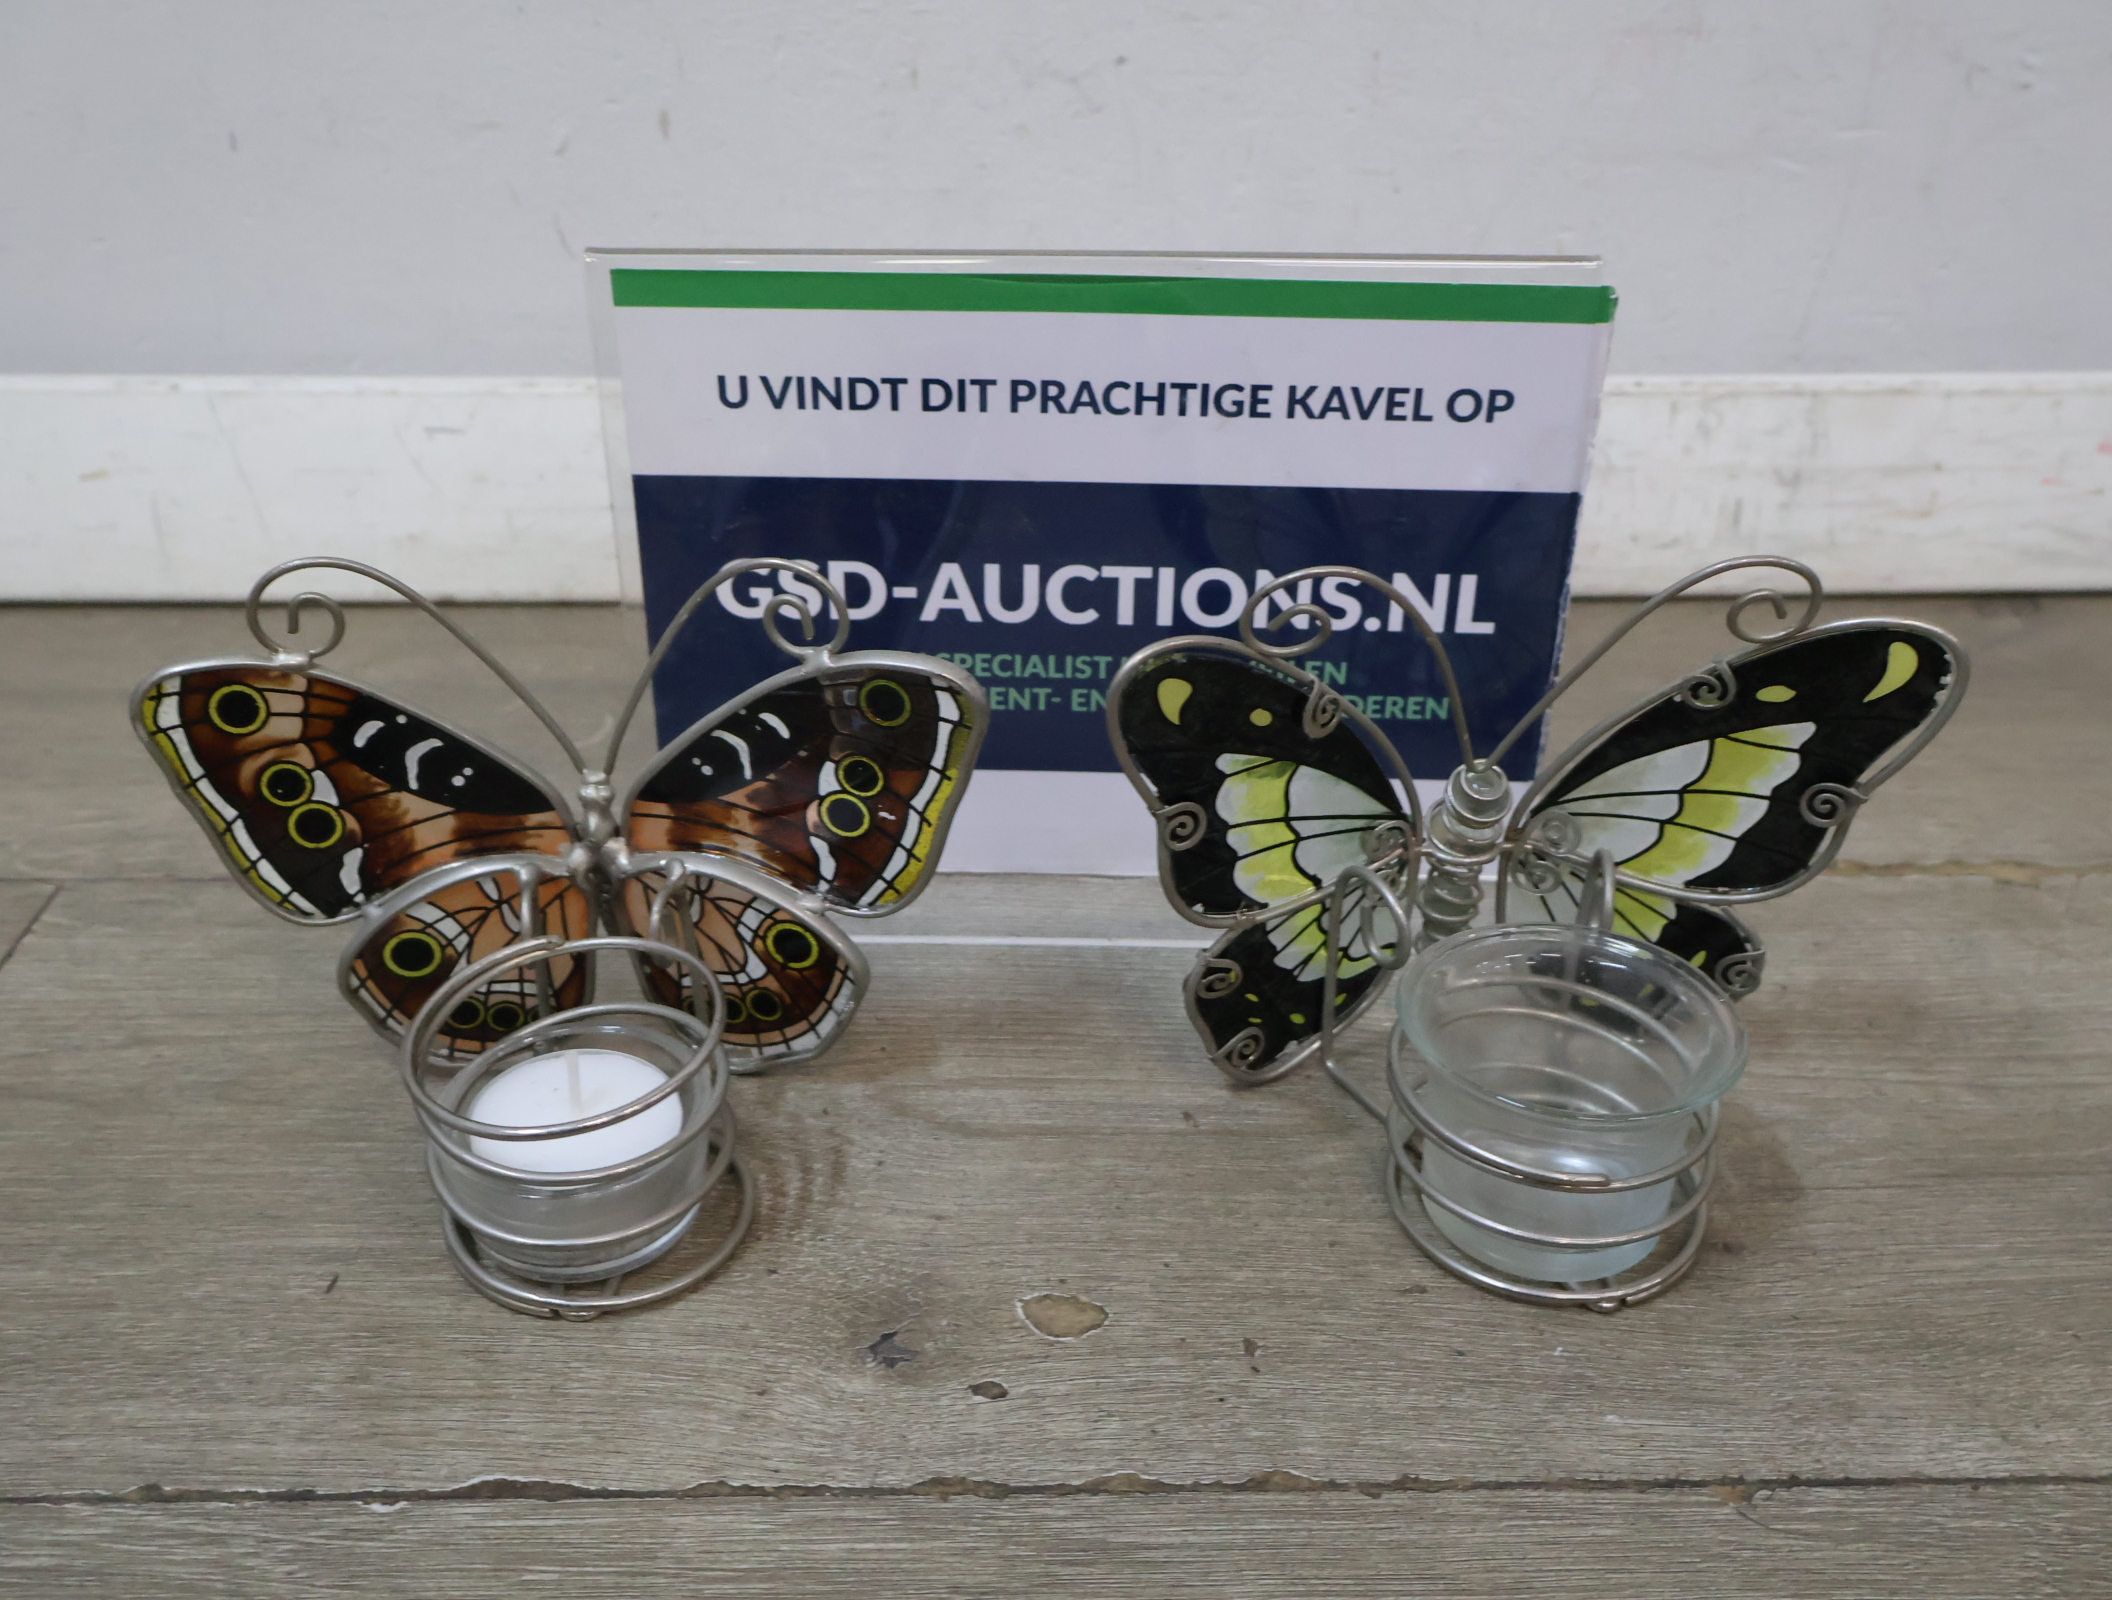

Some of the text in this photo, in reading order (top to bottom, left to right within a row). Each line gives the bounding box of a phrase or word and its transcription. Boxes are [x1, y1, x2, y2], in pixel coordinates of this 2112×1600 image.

[717, 374, 1515, 423] U VINDT DIT PRACHTIGE KAVEL OP
[715, 557, 1496, 635] GSD-AUCTIONS.NL
[934, 652, 1113, 679] PECIALIST
